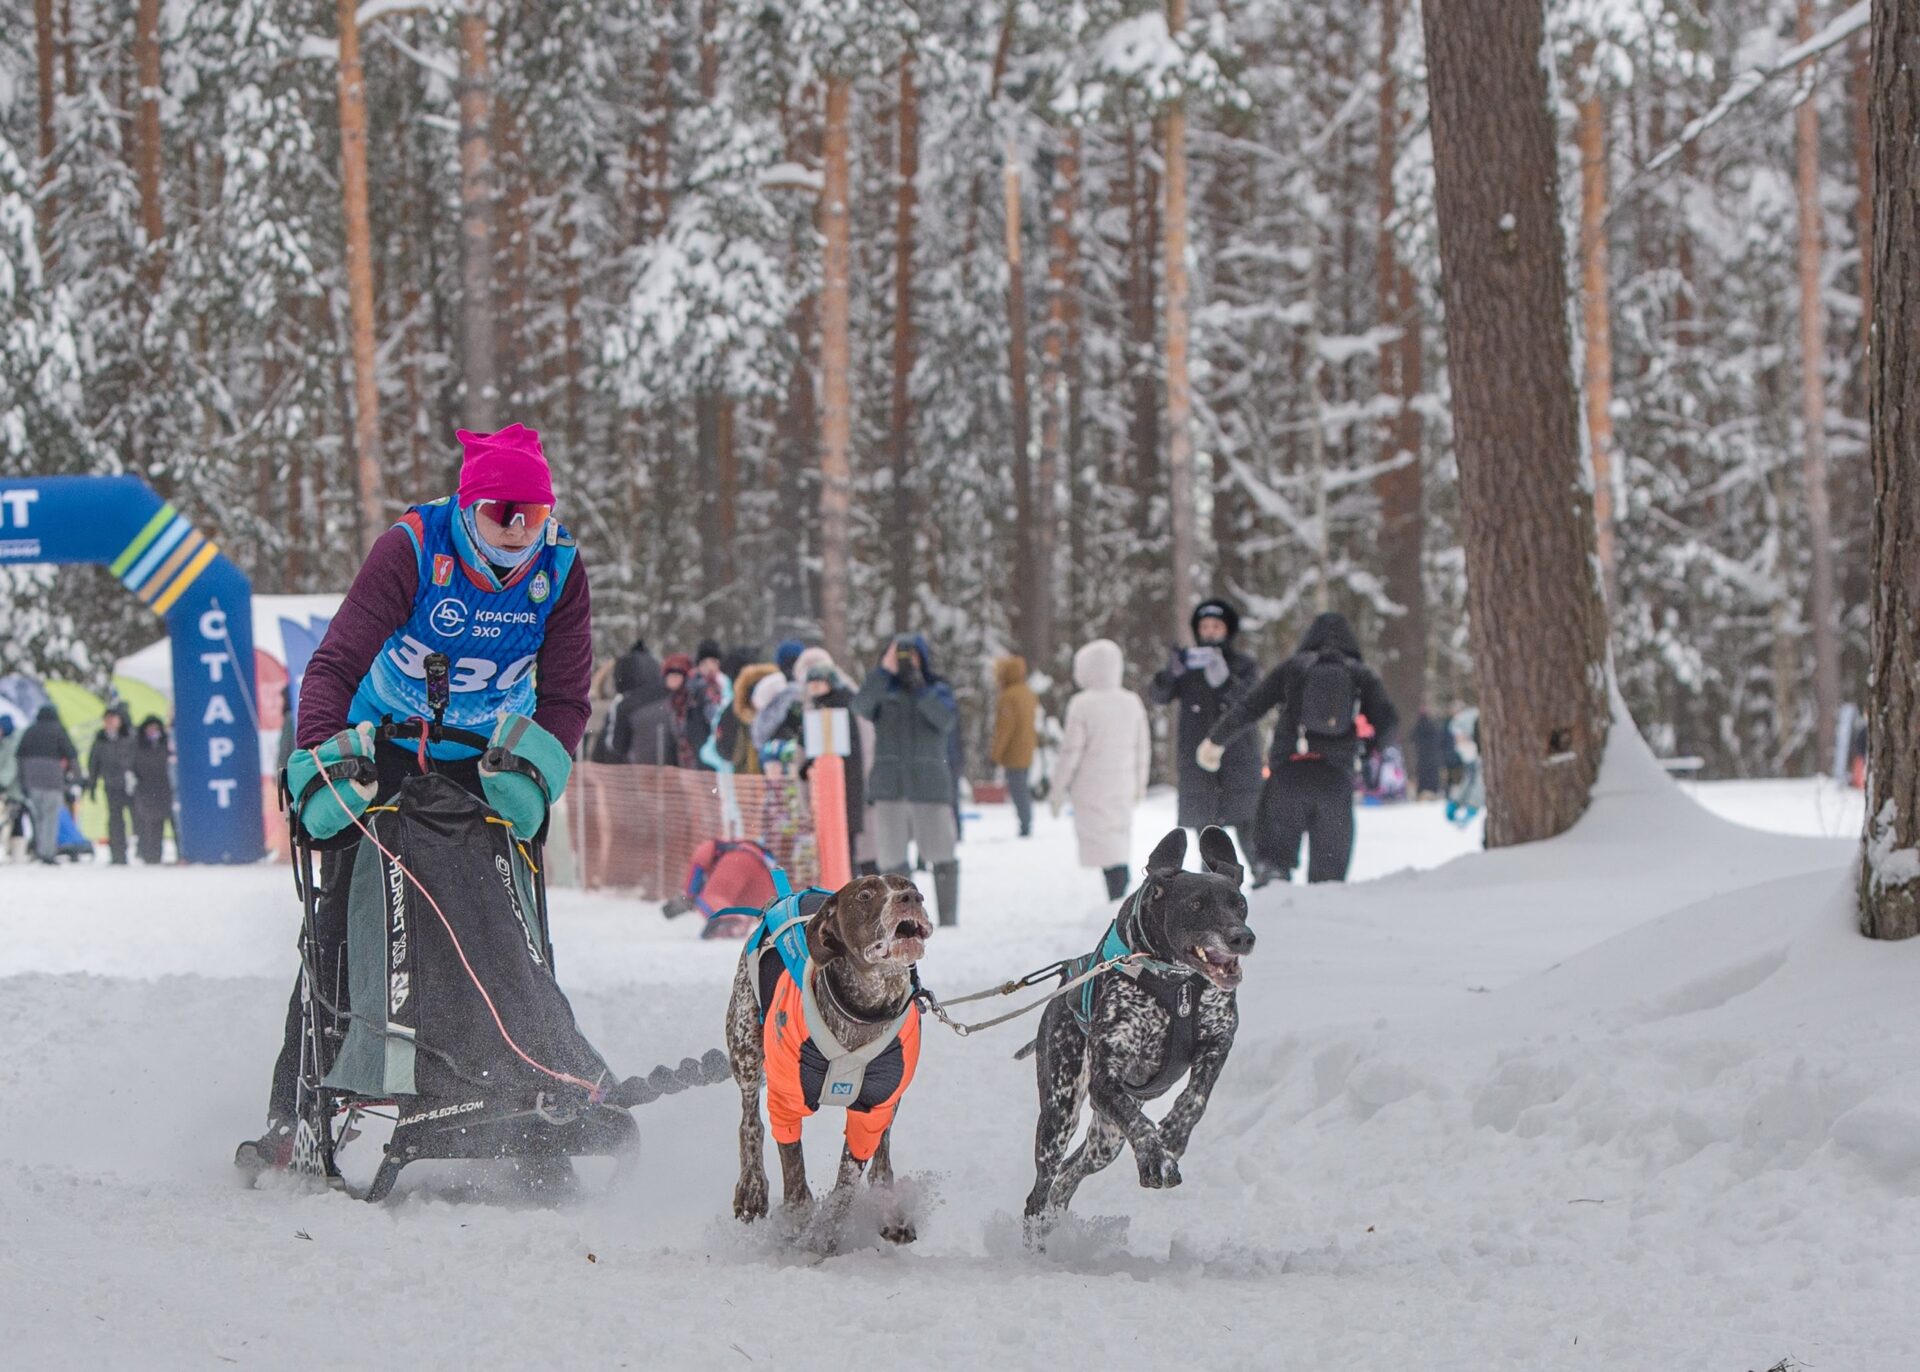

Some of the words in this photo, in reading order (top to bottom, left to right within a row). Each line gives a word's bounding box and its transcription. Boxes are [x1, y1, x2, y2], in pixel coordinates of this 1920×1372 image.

[471, 625, 501, 638] ЭХО
[475, 609, 537, 624] КРАСНОЕ
[388, 634, 538, 692] 330
[199, 610, 237, 809] СТАРТ
[389, 854, 405, 933] HORNET
